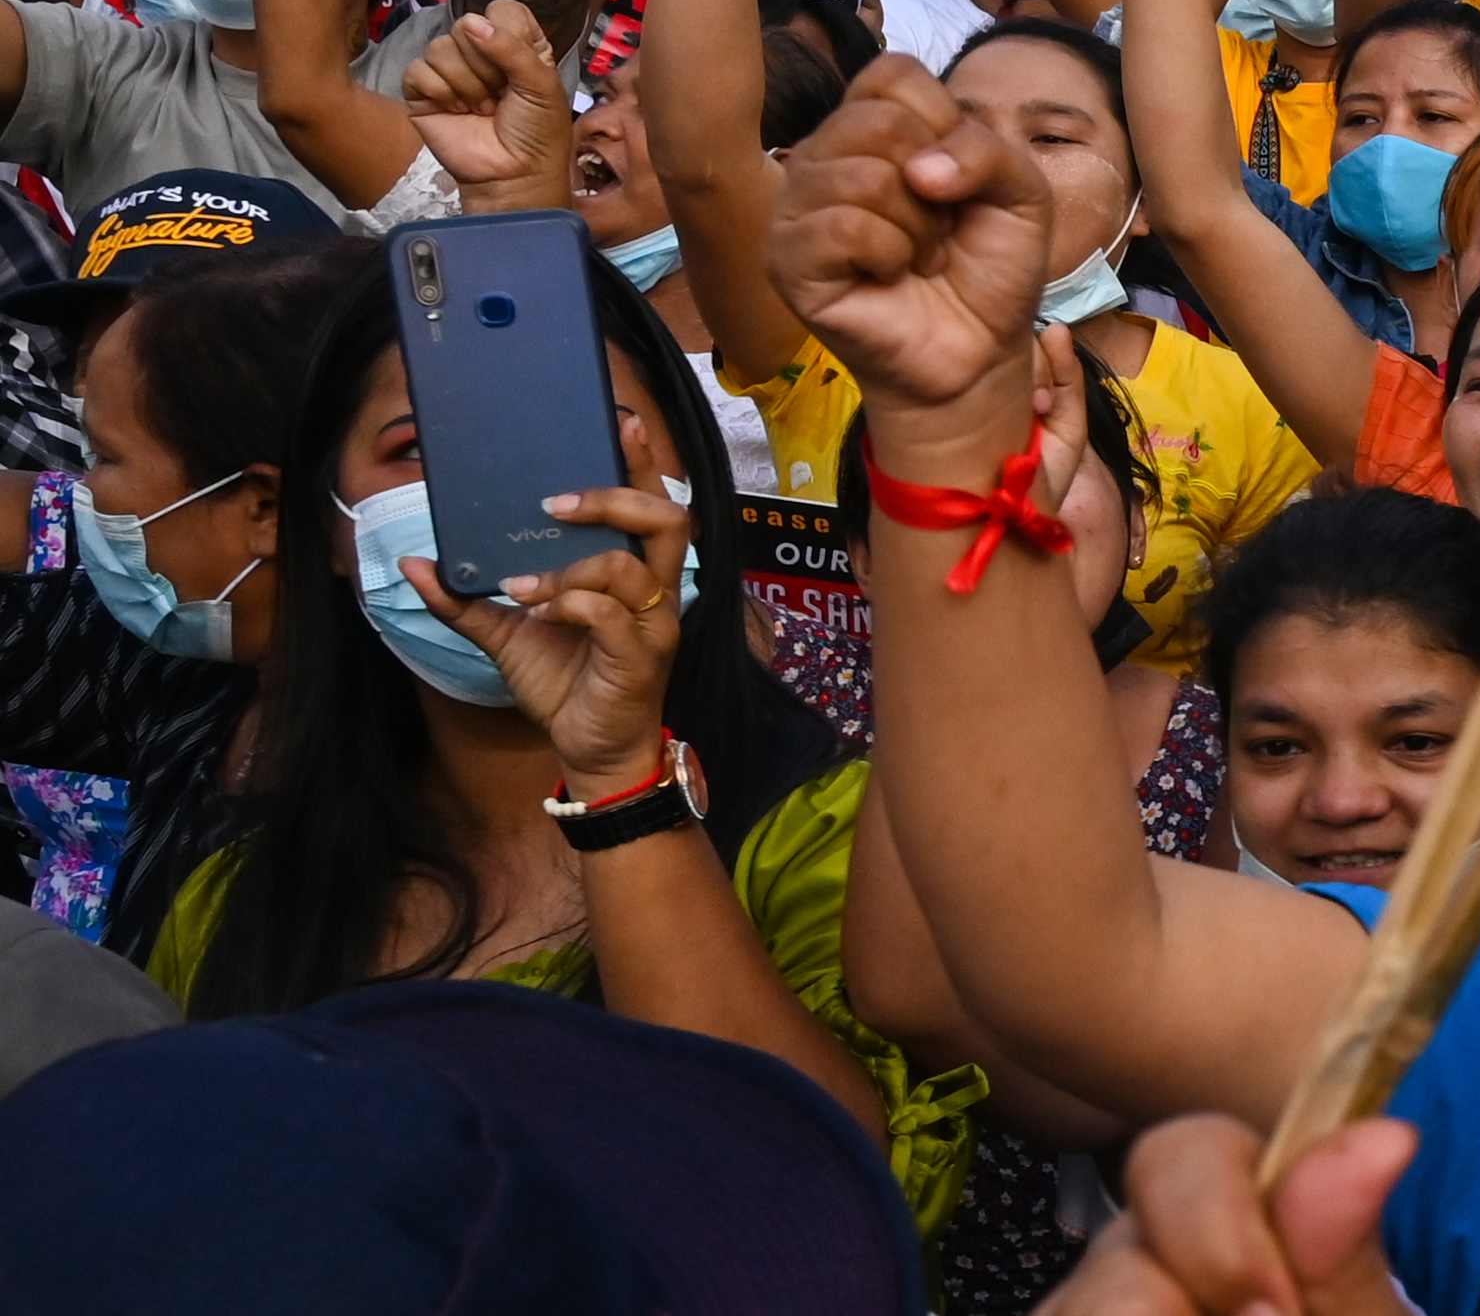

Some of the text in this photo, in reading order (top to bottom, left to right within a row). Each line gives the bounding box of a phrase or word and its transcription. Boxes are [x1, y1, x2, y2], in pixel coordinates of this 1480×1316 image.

[100, 186, 271, 222] WHAT'S YOUR
[77, 205, 256, 280] Signature
[505, 526, 562, 543] vivo
[741, 507, 831, 534] ease
[775, 541, 850, 574] OUR
